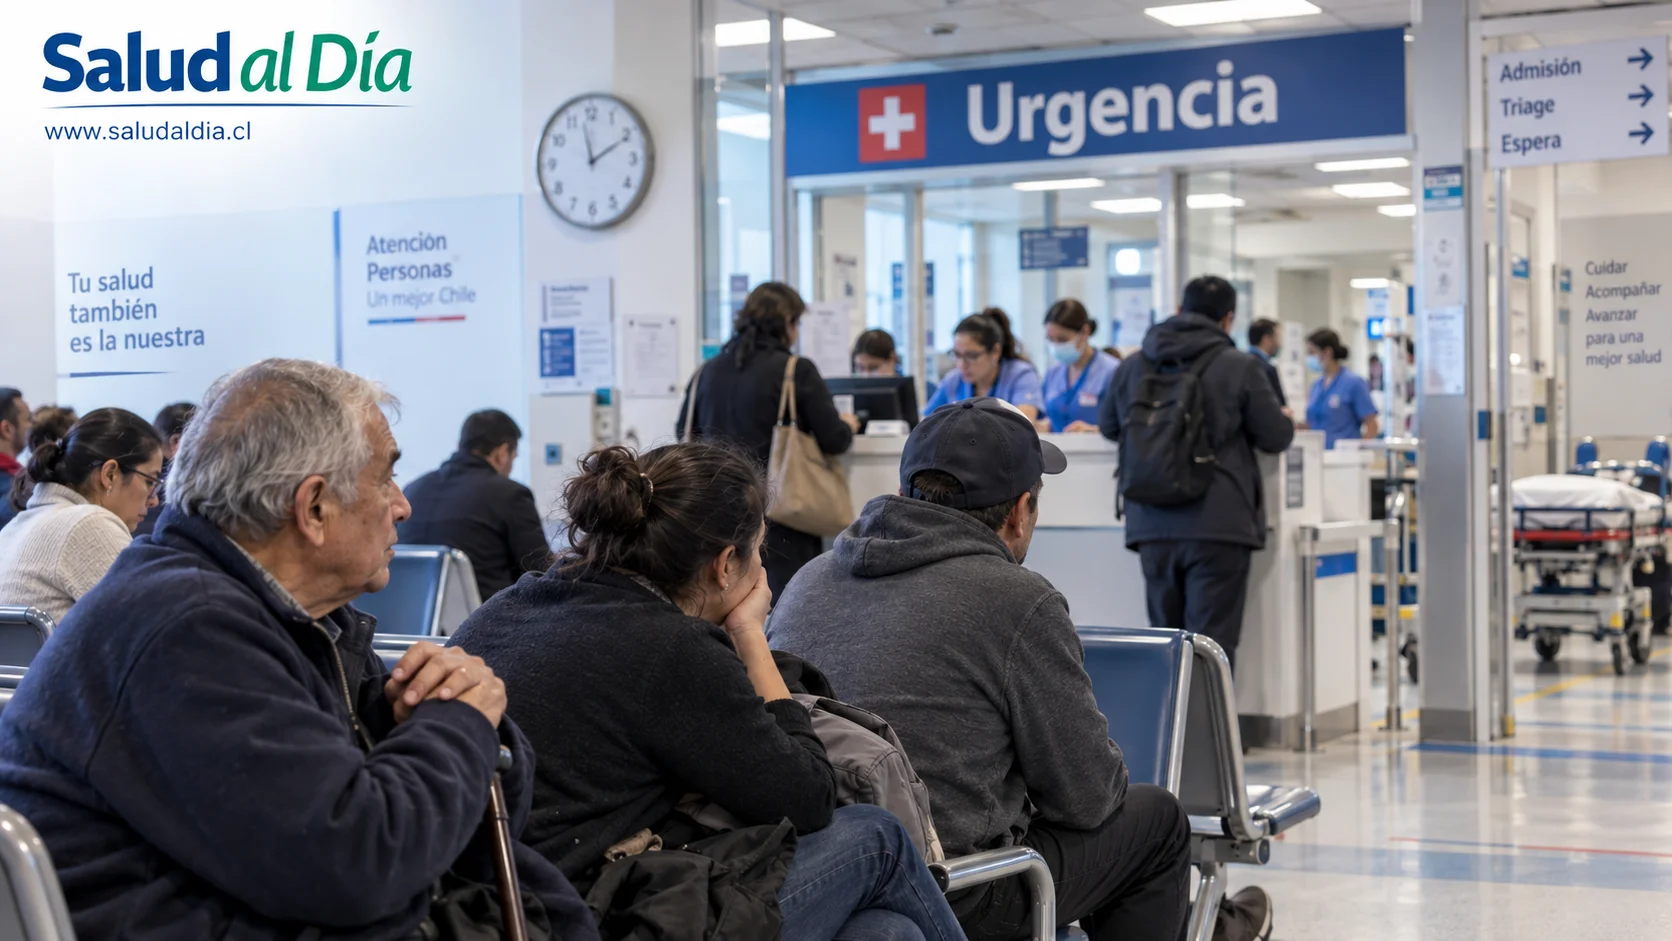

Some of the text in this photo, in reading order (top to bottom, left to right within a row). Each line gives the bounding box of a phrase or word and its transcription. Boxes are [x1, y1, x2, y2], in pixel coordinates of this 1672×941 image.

[1499, 57, 1582, 83] Admisión
[585, 106, 598, 121] 12
[967, 60, 1279, 157] Urgencia
[1500, 97, 1556, 121] Triage
[567, 116, 578, 129] 11
[608, 112, 615, 125] 1
[553, 134, 565, 147] 10
[621, 128, 631, 142] 2
[1501, 132, 1562, 157] Espera
[547, 159, 557, 172] 9
[629, 152, 637, 166] 3
[554, 181, 563, 195] 8
[623, 176, 631, 189] 4
[569, 197, 578, 211] 7
[588, 201, 597, 216] 6
[609, 195, 617, 209] 5
[366, 232, 448, 255] Atención
[367, 260, 453, 282] Personas
[1585, 259, 1629, 276] Cuidar
[68, 266, 154, 294] Tu salud
[391, 287, 435, 311] mejor
[439, 286, 477, 305] Chile
[1585, 281, 1663, 301] Acompañar
[69, 297, 158, 324] también
[1585, 308, 1639, 323] Avanzar
[69, 327, 205, 353] es la nuestra
[1585, 332, 1645, 349] para una
[1585, 348, 1663, 369] mejor salud
